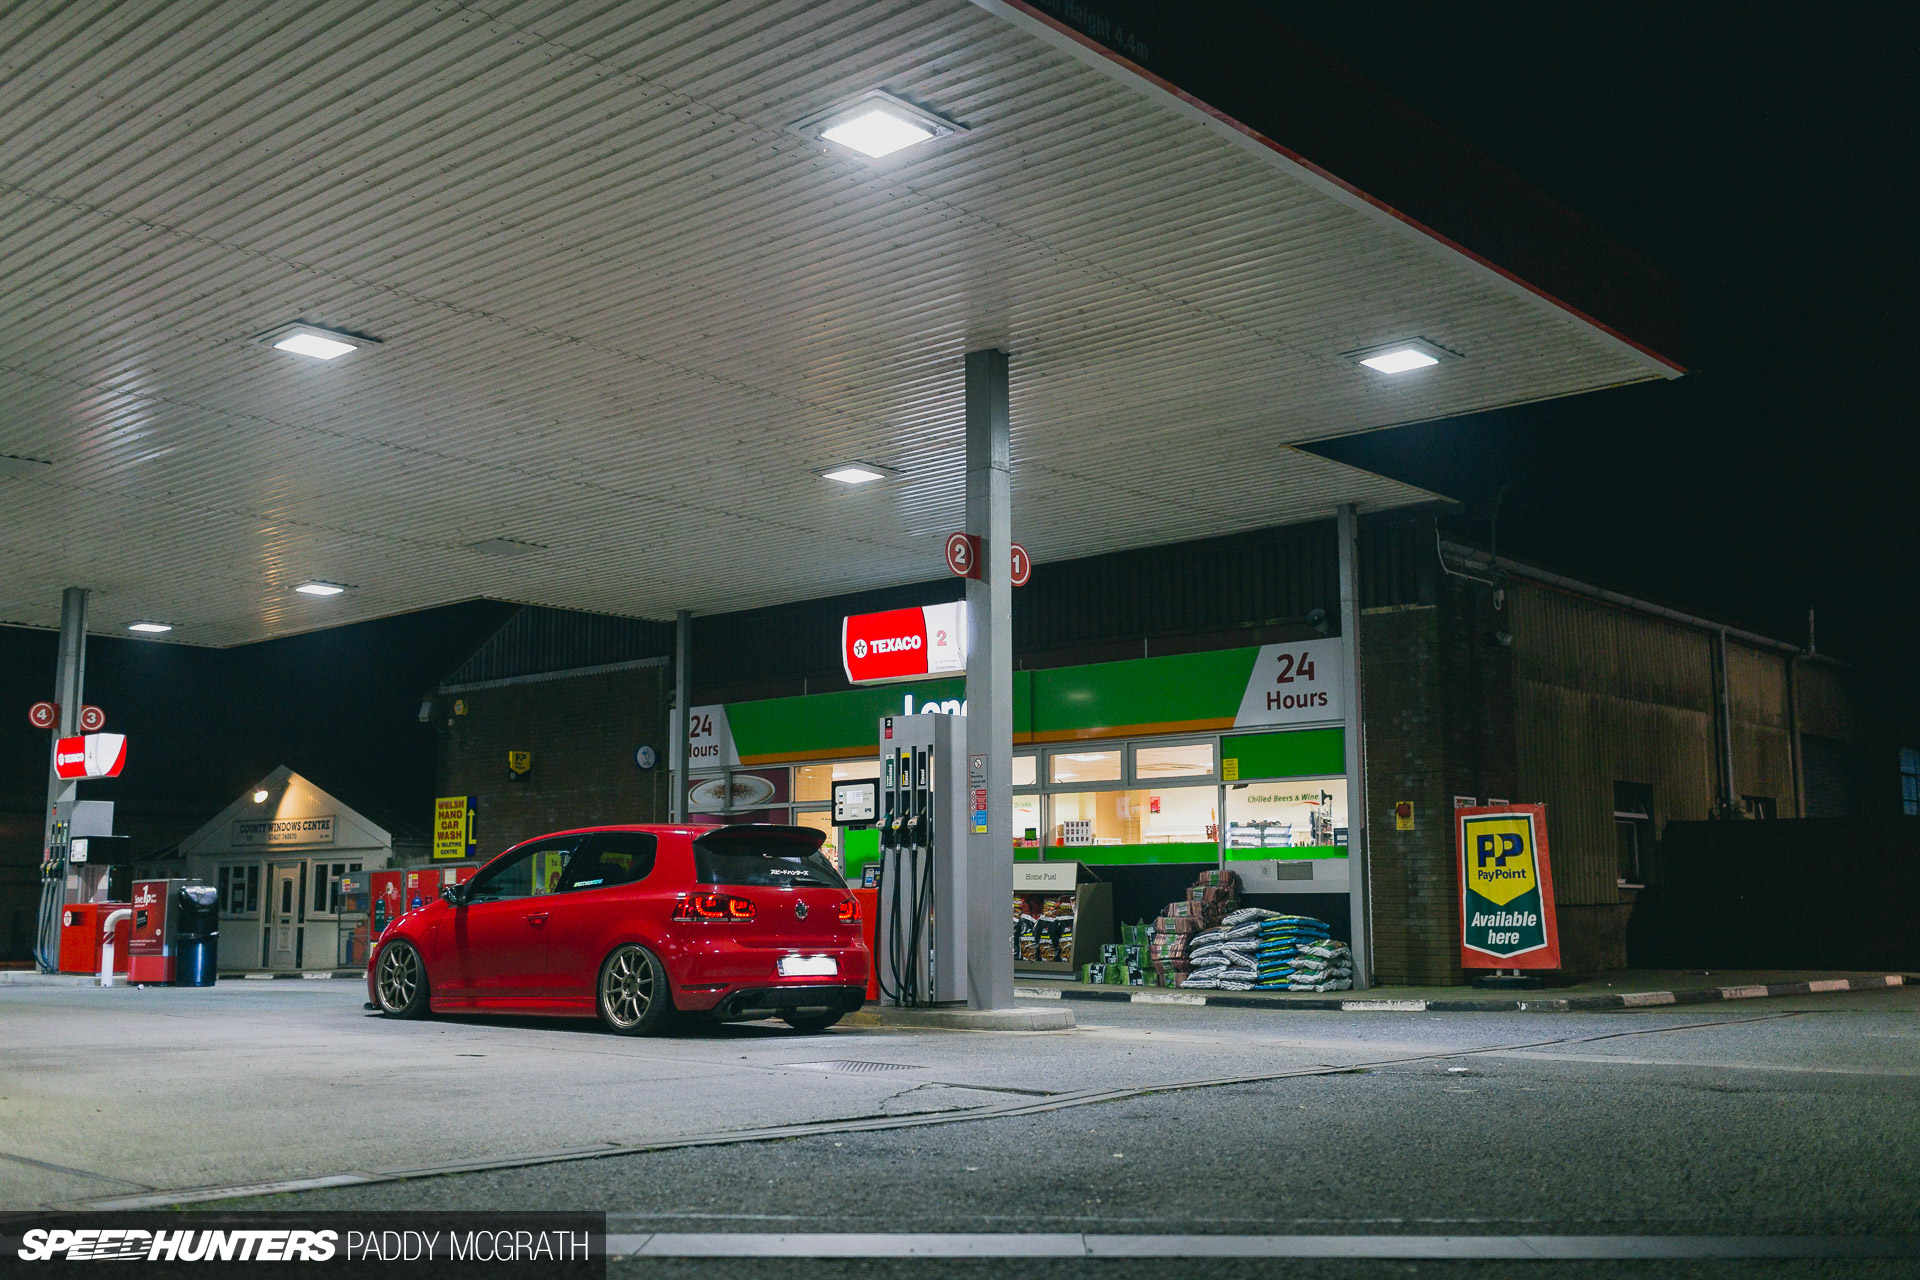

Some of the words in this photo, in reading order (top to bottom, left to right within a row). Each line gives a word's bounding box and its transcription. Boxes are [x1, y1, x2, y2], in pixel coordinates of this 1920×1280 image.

[954, 544, 966, 564] 2
[1012, 554, 1020, 574] 1
[870, 635, 922, 654] TEXACO
[936, 629, 948, 647] 2
[1276, 651, 1315, 684] 24
[1266, 690, 1328, 711] Hours
[36, 708, 47, 720] 4
[87, 712, 96, 724] 3
[690, 714, 713, 738] 24
[886, 719, 892, 727] 2
[438, 800, 464, 809] WELSH
[1247, 795, 1271, 803] Chilled
[1273, 794, 1293, 802] Beers
[438, 810, 463, 820] HAND
[239, 823, 266, 834] COUNTY
[268, 821, 301, 832] WINDOWS
[302, 820, 331, 831] CENTRE
[441, 820, 459, 830] CAR
[437, 830, 462, 840] WASH
[1025, 873, 1043, 881] Home
[1043, 873, 1057, 881] Fuel
[1477, 868, 1527, 882] PayPoint
[1470, 911, 1538, 928] Available
[1487, 929, 1520, 945] here
